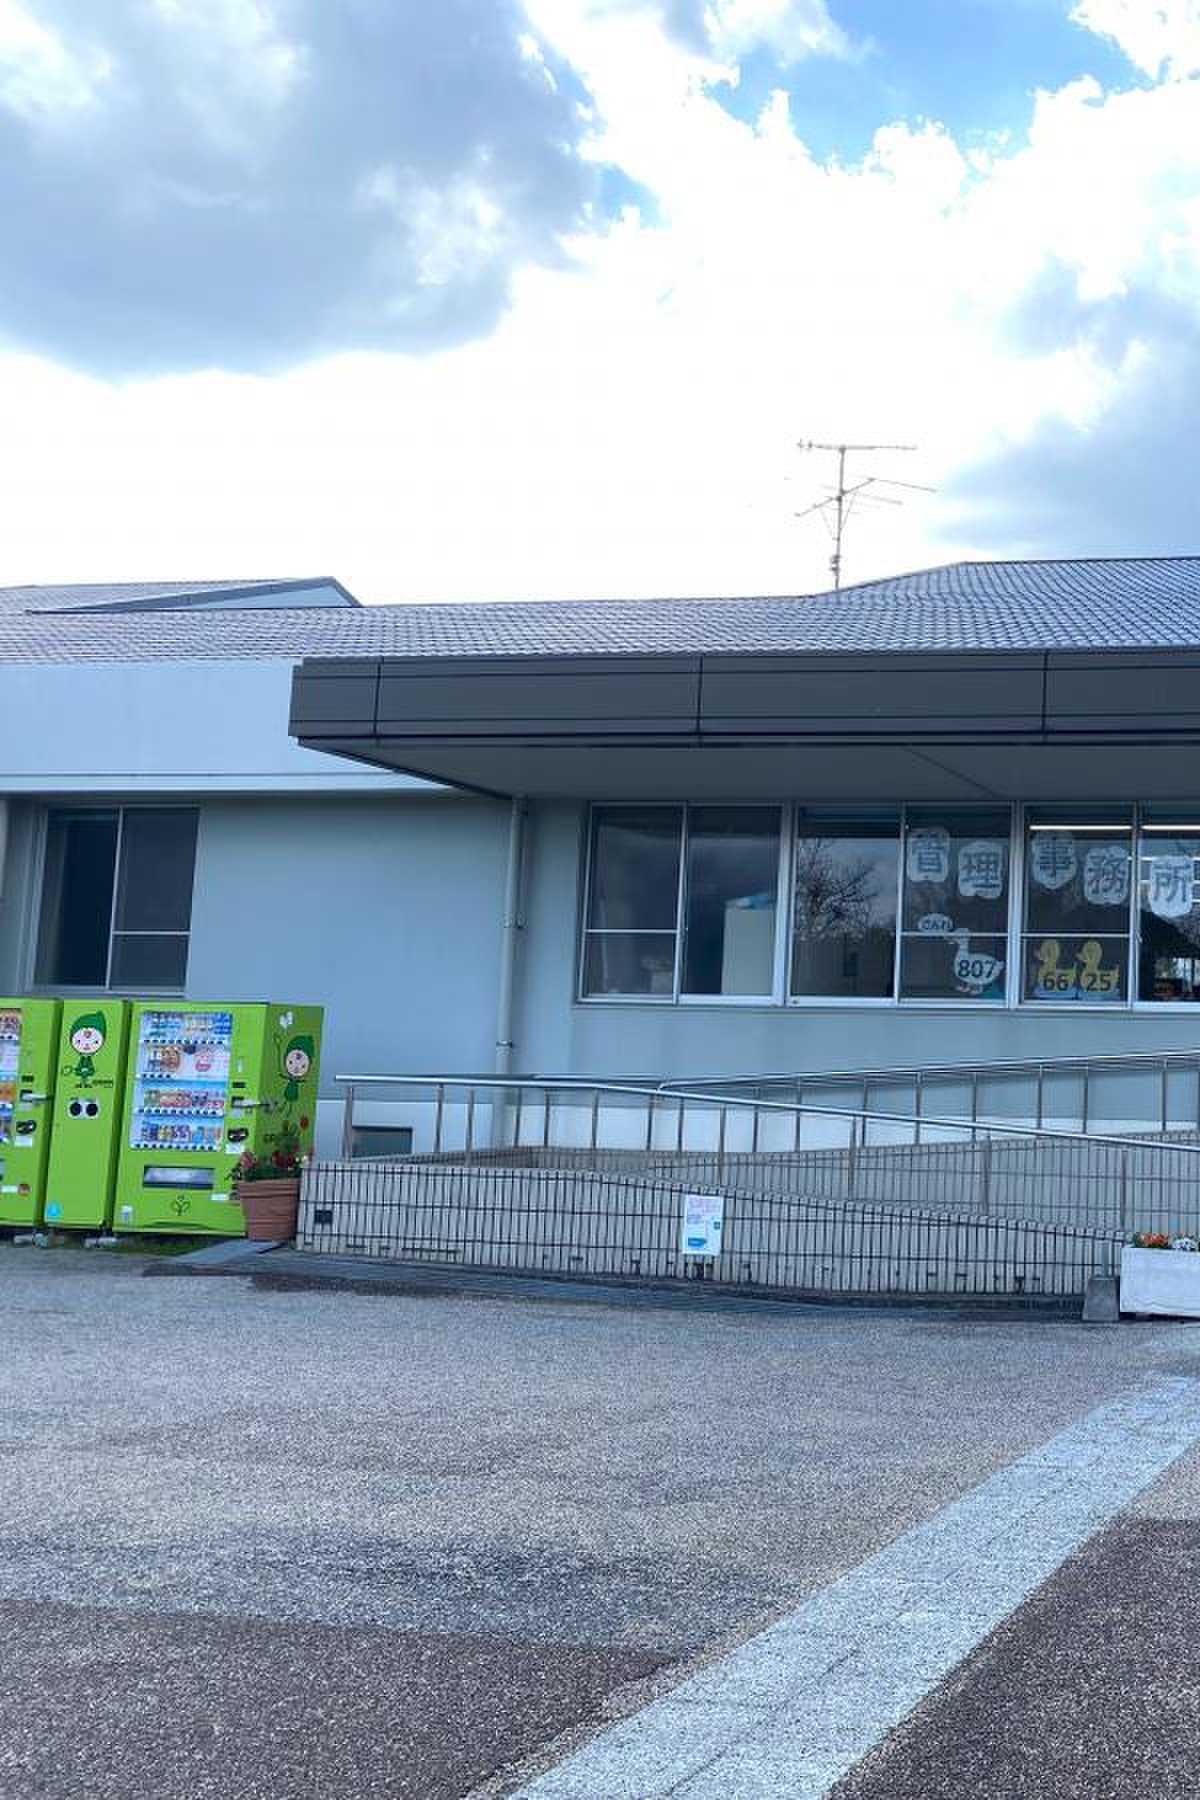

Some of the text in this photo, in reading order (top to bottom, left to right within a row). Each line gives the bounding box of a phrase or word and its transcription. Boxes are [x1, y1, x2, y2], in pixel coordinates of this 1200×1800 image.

[958, 959, 995, 978] 807
[1043, 973, 1111, 992] 66 25
